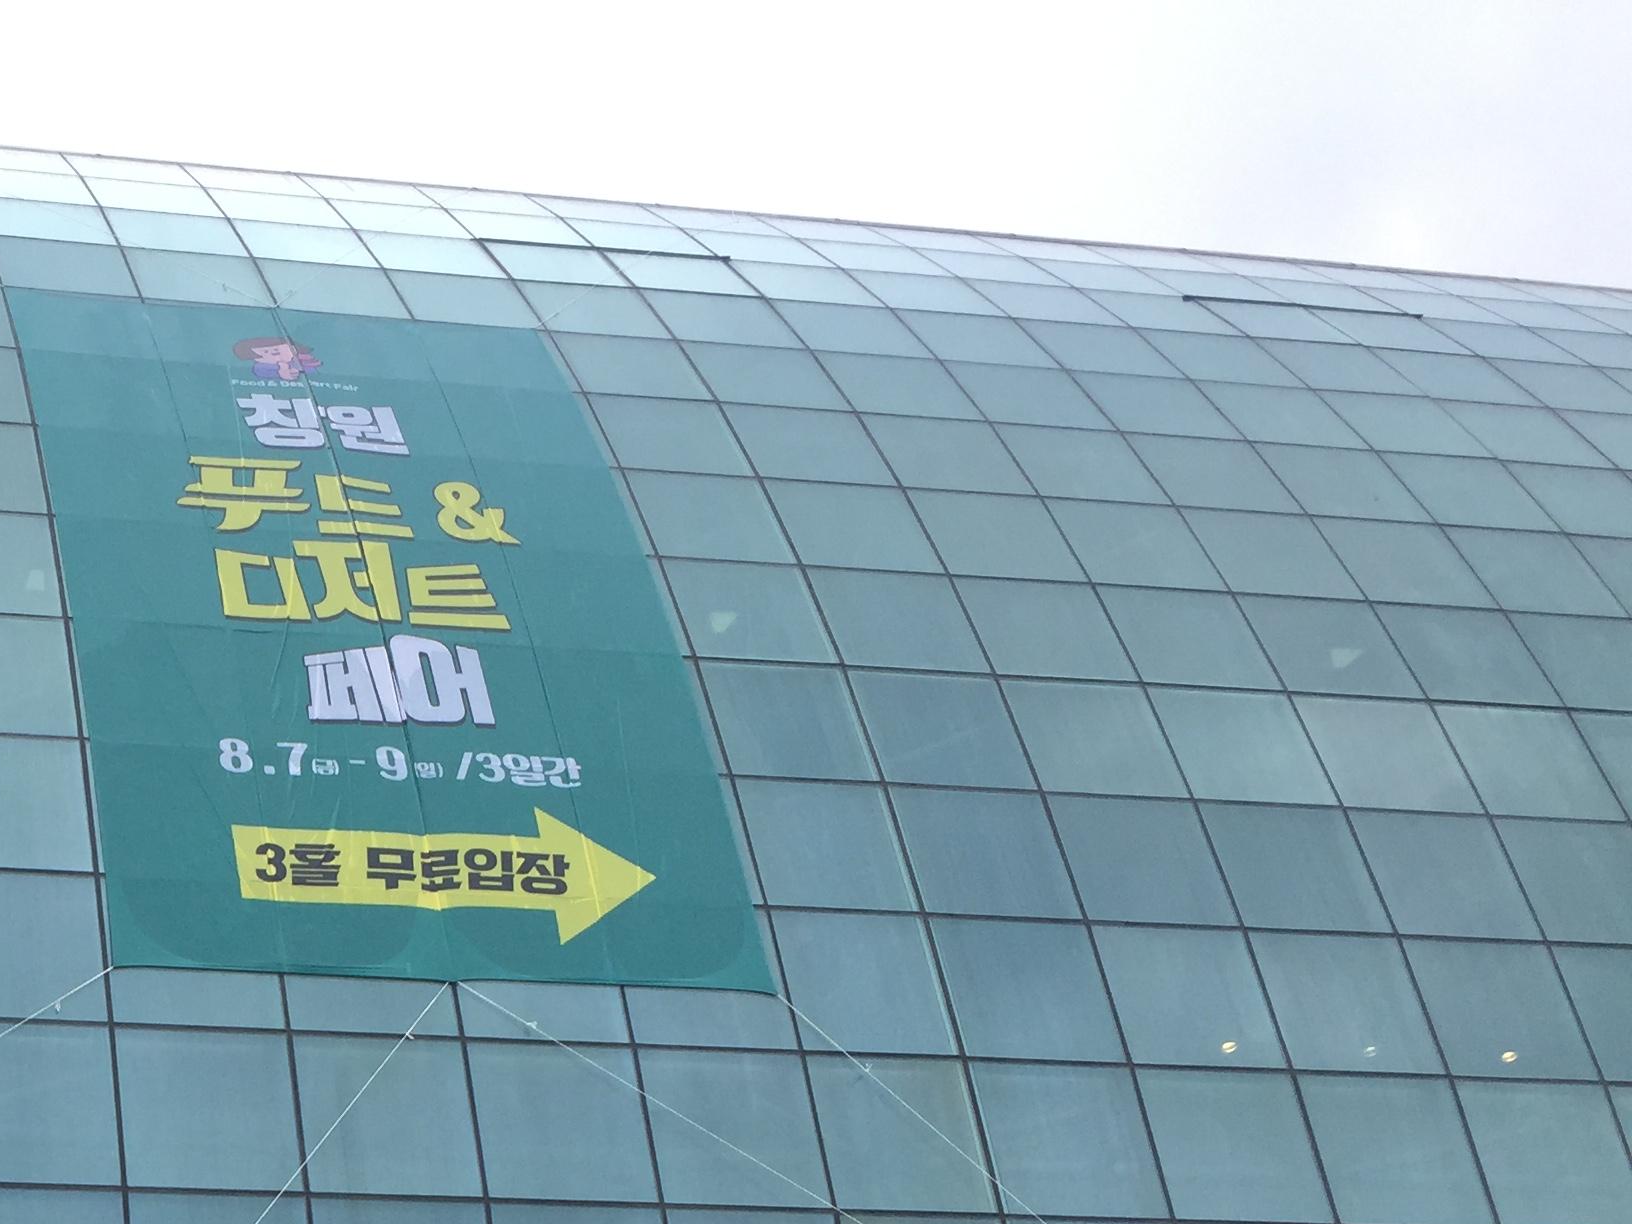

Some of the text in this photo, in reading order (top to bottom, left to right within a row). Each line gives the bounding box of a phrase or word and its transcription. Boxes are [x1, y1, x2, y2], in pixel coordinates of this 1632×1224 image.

[232, 379, 265, 388] Food
[333, 383, 359, 392] Fair
[236, 393, 410, 456] 창원
[176, 454, 522, 546] 푸드 &
[214, 540, 513, 632] 디저트
[302, 633, 497, 727] 페어
[254, 842, 571, 896] 3홀 무료입장
